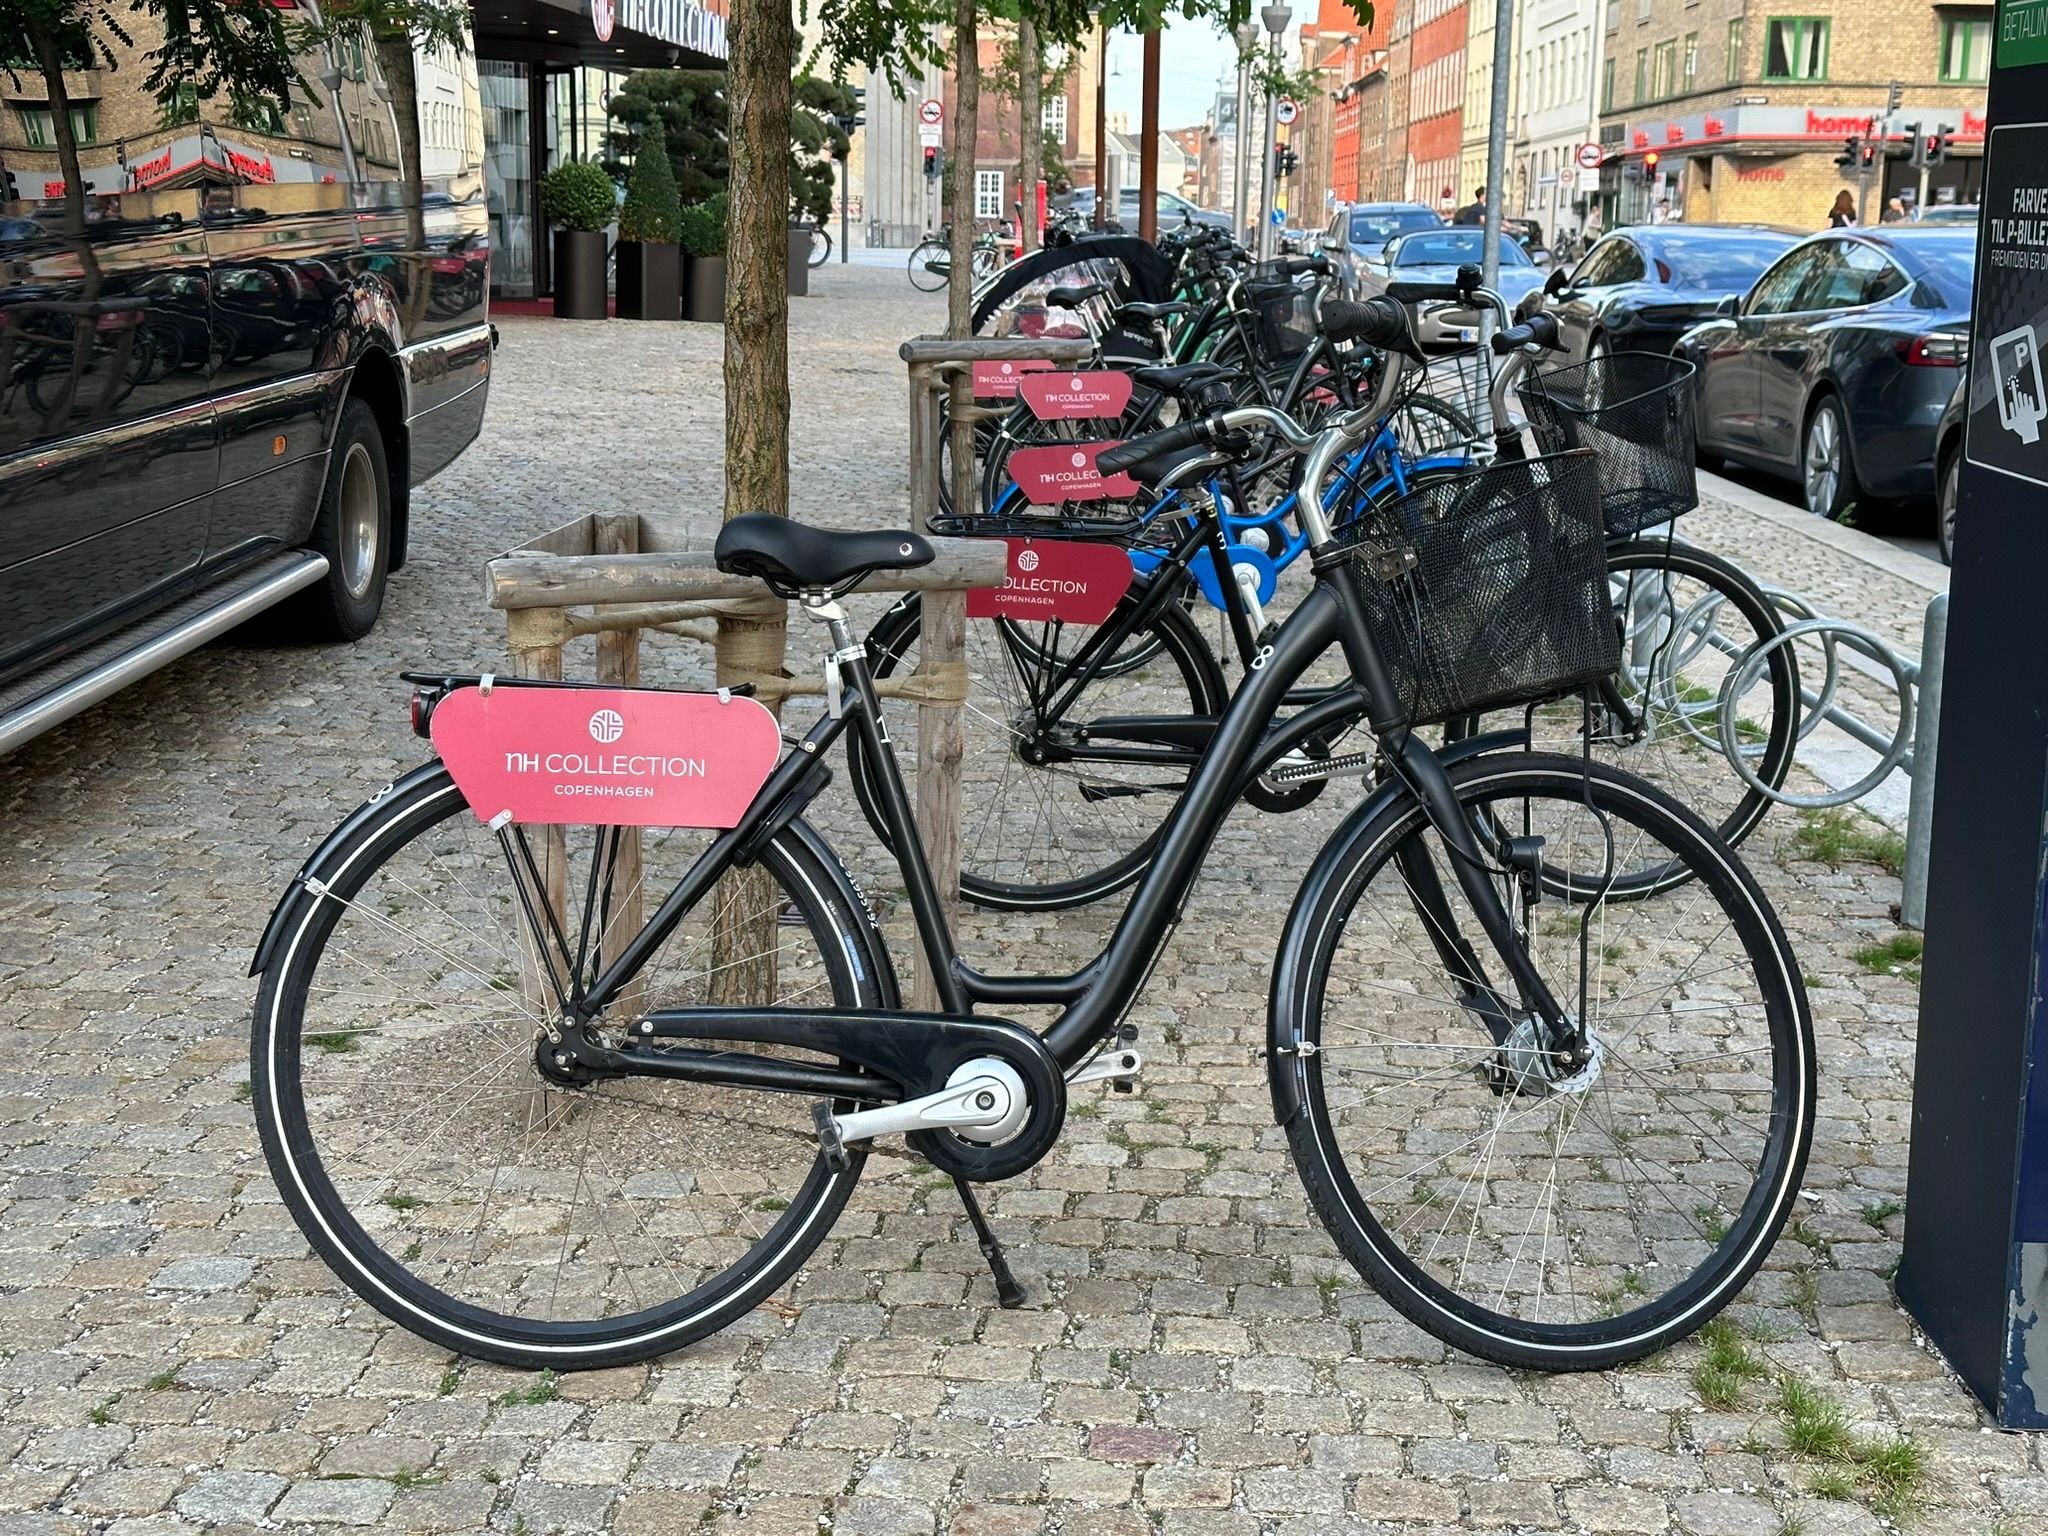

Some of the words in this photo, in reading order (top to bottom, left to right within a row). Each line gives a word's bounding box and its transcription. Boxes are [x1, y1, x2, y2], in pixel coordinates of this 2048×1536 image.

[1807, 109, 1876, 133] home
[1737, 164, 1785, 182] home
[2012, 188, 2048, 213] FARVE
[1991, 219, 2004, 243] TIL
[1991, 249, 2029, 268] FREMTIDEN
[2029, 252, 2040, 270] ER
[1059, 393, 1110, 402] COLLECTION
[1061, 482, 1101, 491] COPENHAGEN
[1216, 531, 1227, 550] 3
[994, 576, 1088, 595] OLLECTION
[994, 594, 1055, 605] COPENHAGEN
[1251, 645, 1274, 670] 8
[876, 715, 892, 743] 1
[545, 753, 706, 778] COLLECTION
[368, 783, 394, 804] 8
[554, 784, 655, 798] COPENHAGEN
